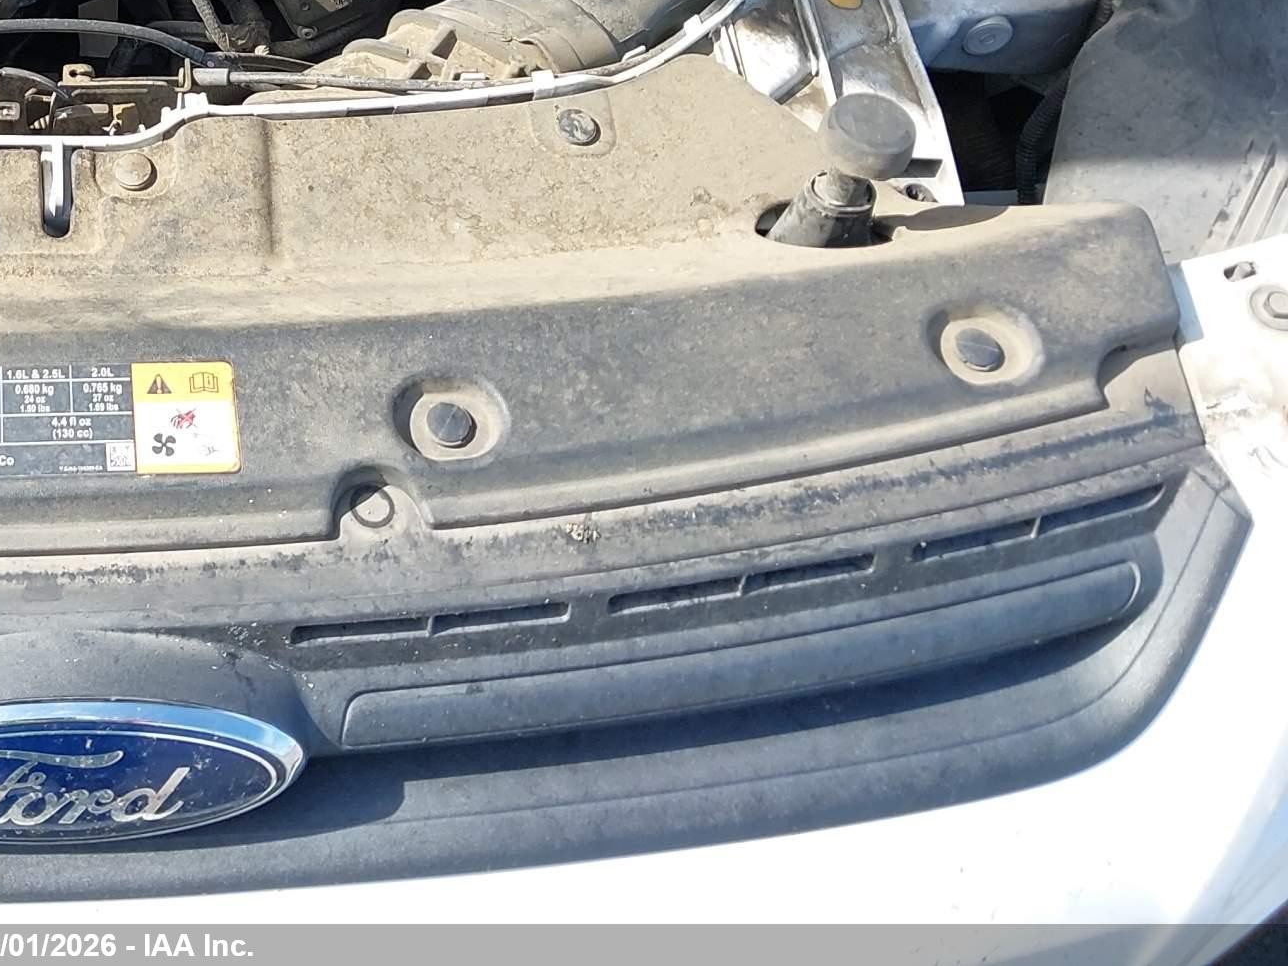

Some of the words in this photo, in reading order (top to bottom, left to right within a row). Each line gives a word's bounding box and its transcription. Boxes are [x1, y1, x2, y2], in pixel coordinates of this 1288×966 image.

[32, 368, 41, 379] &
[91, 367, 114, 378] 2.0L
[41, 383, 55, 397] kg
[110, 382, 123, 395] kg
[24, 395, 35, 403] 24
[36, 395, 46, 403] oz
[104, 395, 114, 403] oz
[37, 403, 51, 413] lbs
[106, 402, 119, 412] lbs
[51, 417, 67, 427] 4.4
[79, 416, 92, 427] oz
[52, 429, 75, 440] (130
[77, 428, 94, 440] cc)
